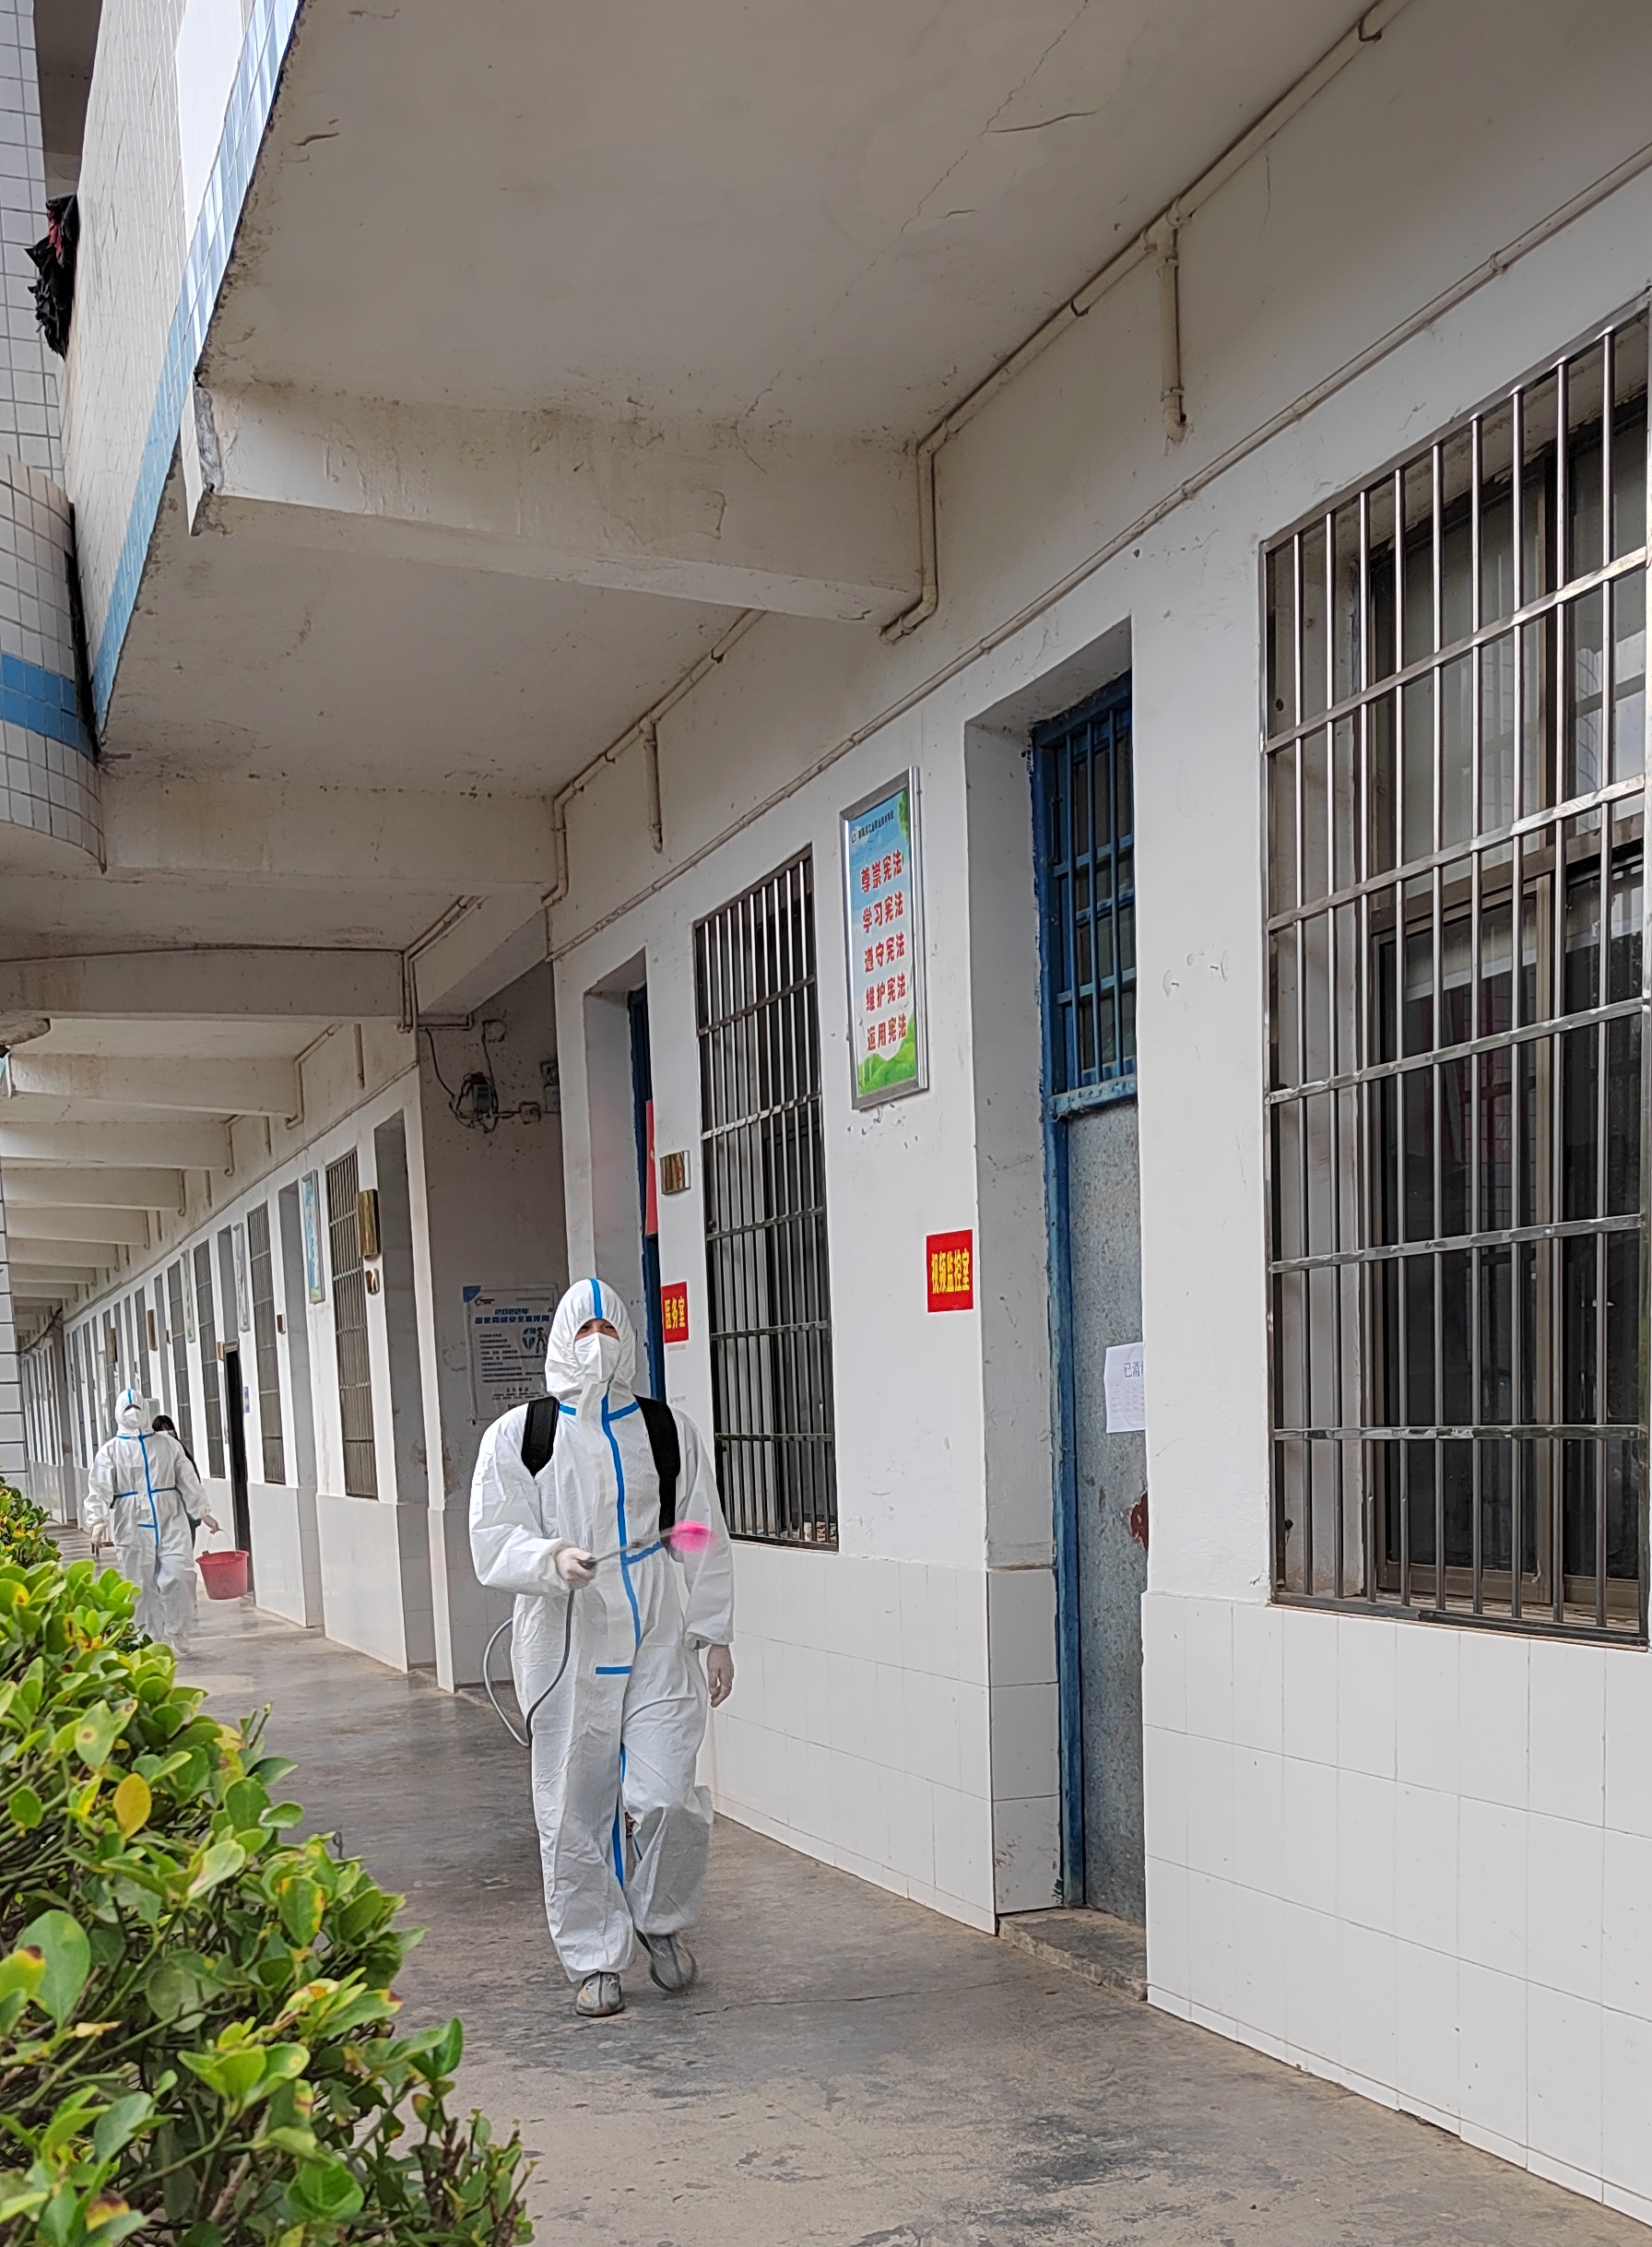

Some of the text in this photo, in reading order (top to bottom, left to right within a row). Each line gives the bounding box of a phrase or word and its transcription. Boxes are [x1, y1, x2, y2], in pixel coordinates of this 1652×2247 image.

[860, 849, 903, 893] 尊崇宪法
[862, 891, 904, 933] 学习宪法
[864, 931, 905, 974] 遵守宪法
[866, 972, 907, 1012] 维护宪法
[867, 1013, 908, 1052] 运用宪法
[931, 1248, 971, 1295] 视频监控室
[664, 1295, 686, 1330] 医务室
